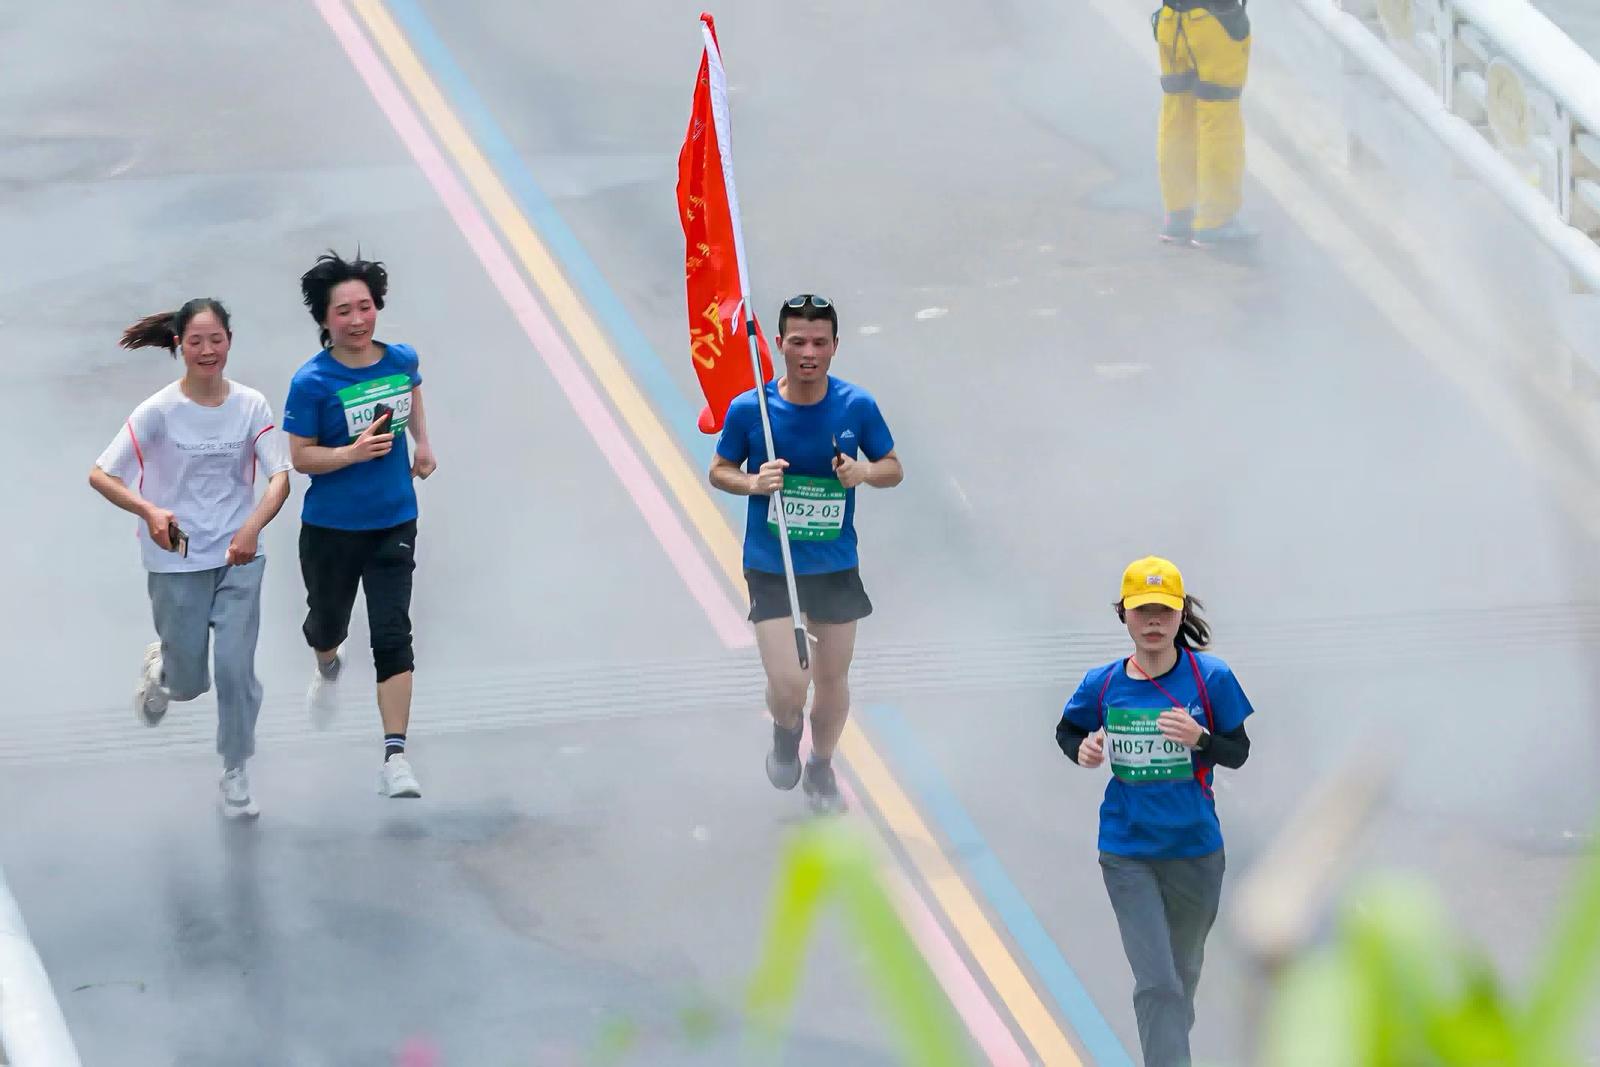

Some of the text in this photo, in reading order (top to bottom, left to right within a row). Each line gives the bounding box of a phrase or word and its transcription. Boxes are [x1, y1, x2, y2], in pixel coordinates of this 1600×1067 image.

[351, 398, 410, 425] H0-05
[774, 502, 841, 518] 052-03
[1112, 739, 1185, 754] H057-08
